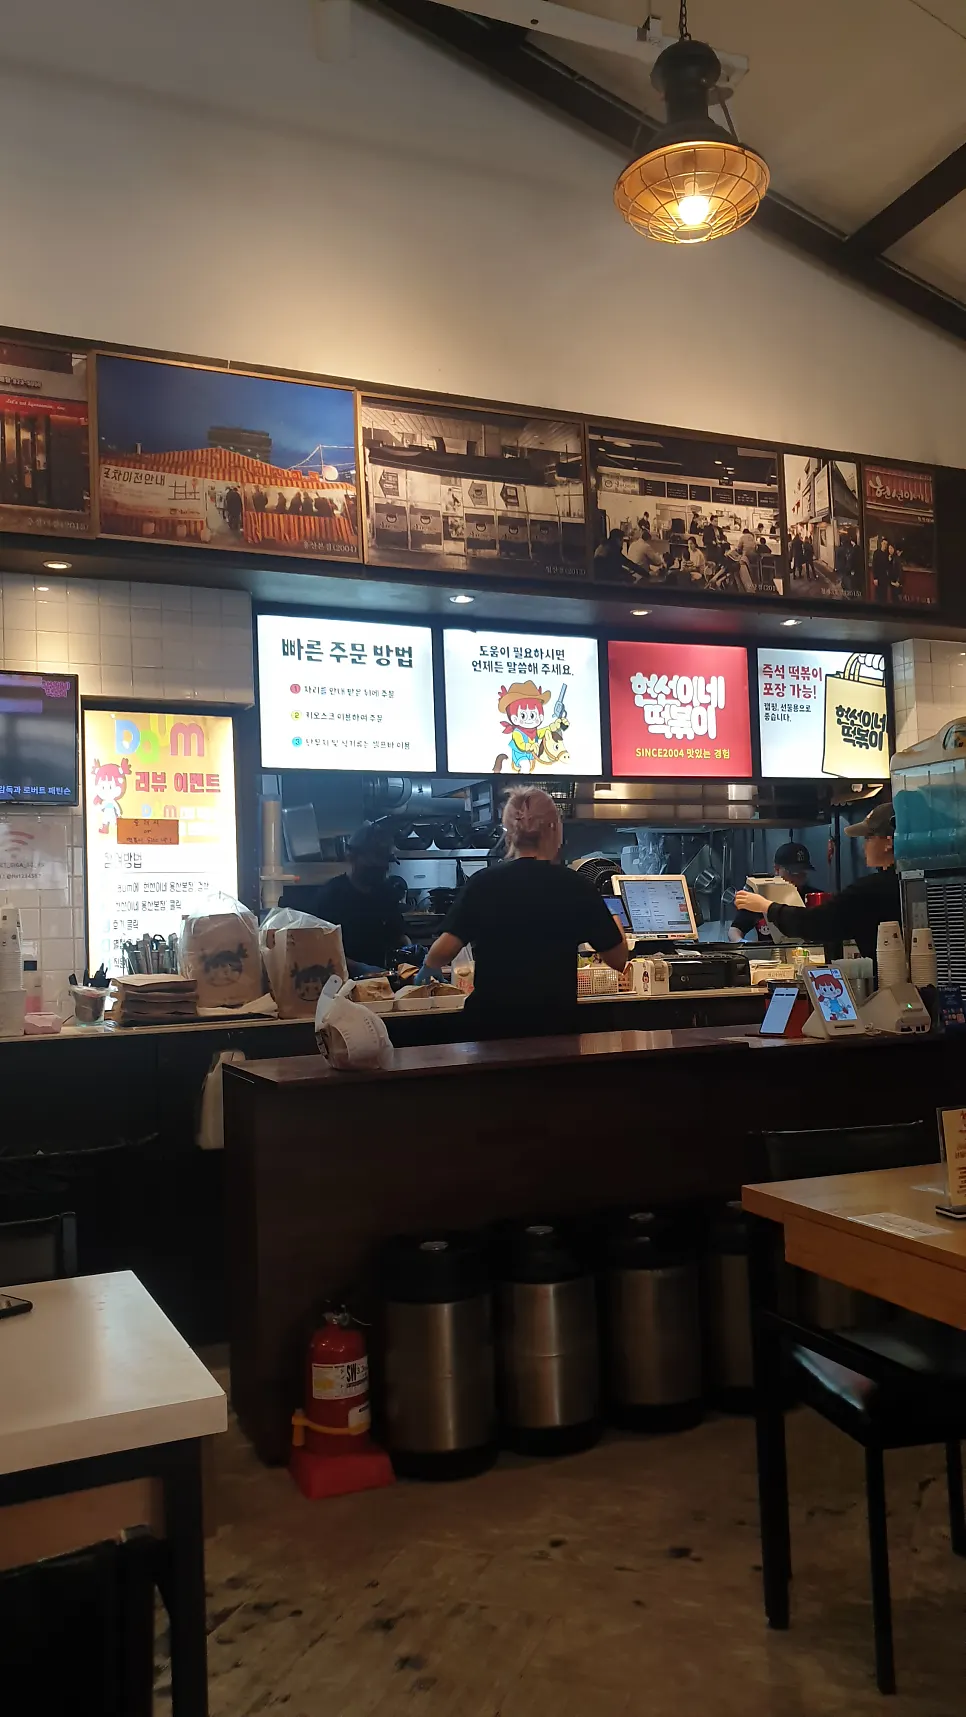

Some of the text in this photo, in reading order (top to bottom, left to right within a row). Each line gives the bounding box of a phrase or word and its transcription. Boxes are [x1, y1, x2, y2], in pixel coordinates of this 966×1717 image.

[281, 638, 413, 668] 빠른 주문 방법
[479, 645, 566, 661] 도움이 필요하시면
[471, 660, 575, 676] 언제든 말씀해 주세요.
[762, 663, 823, 682] 즉석 떡볶이
[381, 690, 395, 699] 주문
[630, 672, 726, 709] 현선이네
[762, 682, 817, 700] 포장 가능!
[780, 703, 812, 713] 선물용으로
[306, 711, 335, 721] 키오스크
[369, 714, 383, 723] 주문
[643, 704, 717, 740] 떡볶이
[635, 748, 730, 759] SINCE2004 맛있는 경험
[135, 771, 221, 793] 리뷰 이벤트
[23, 786, 47, 796] 로버트
